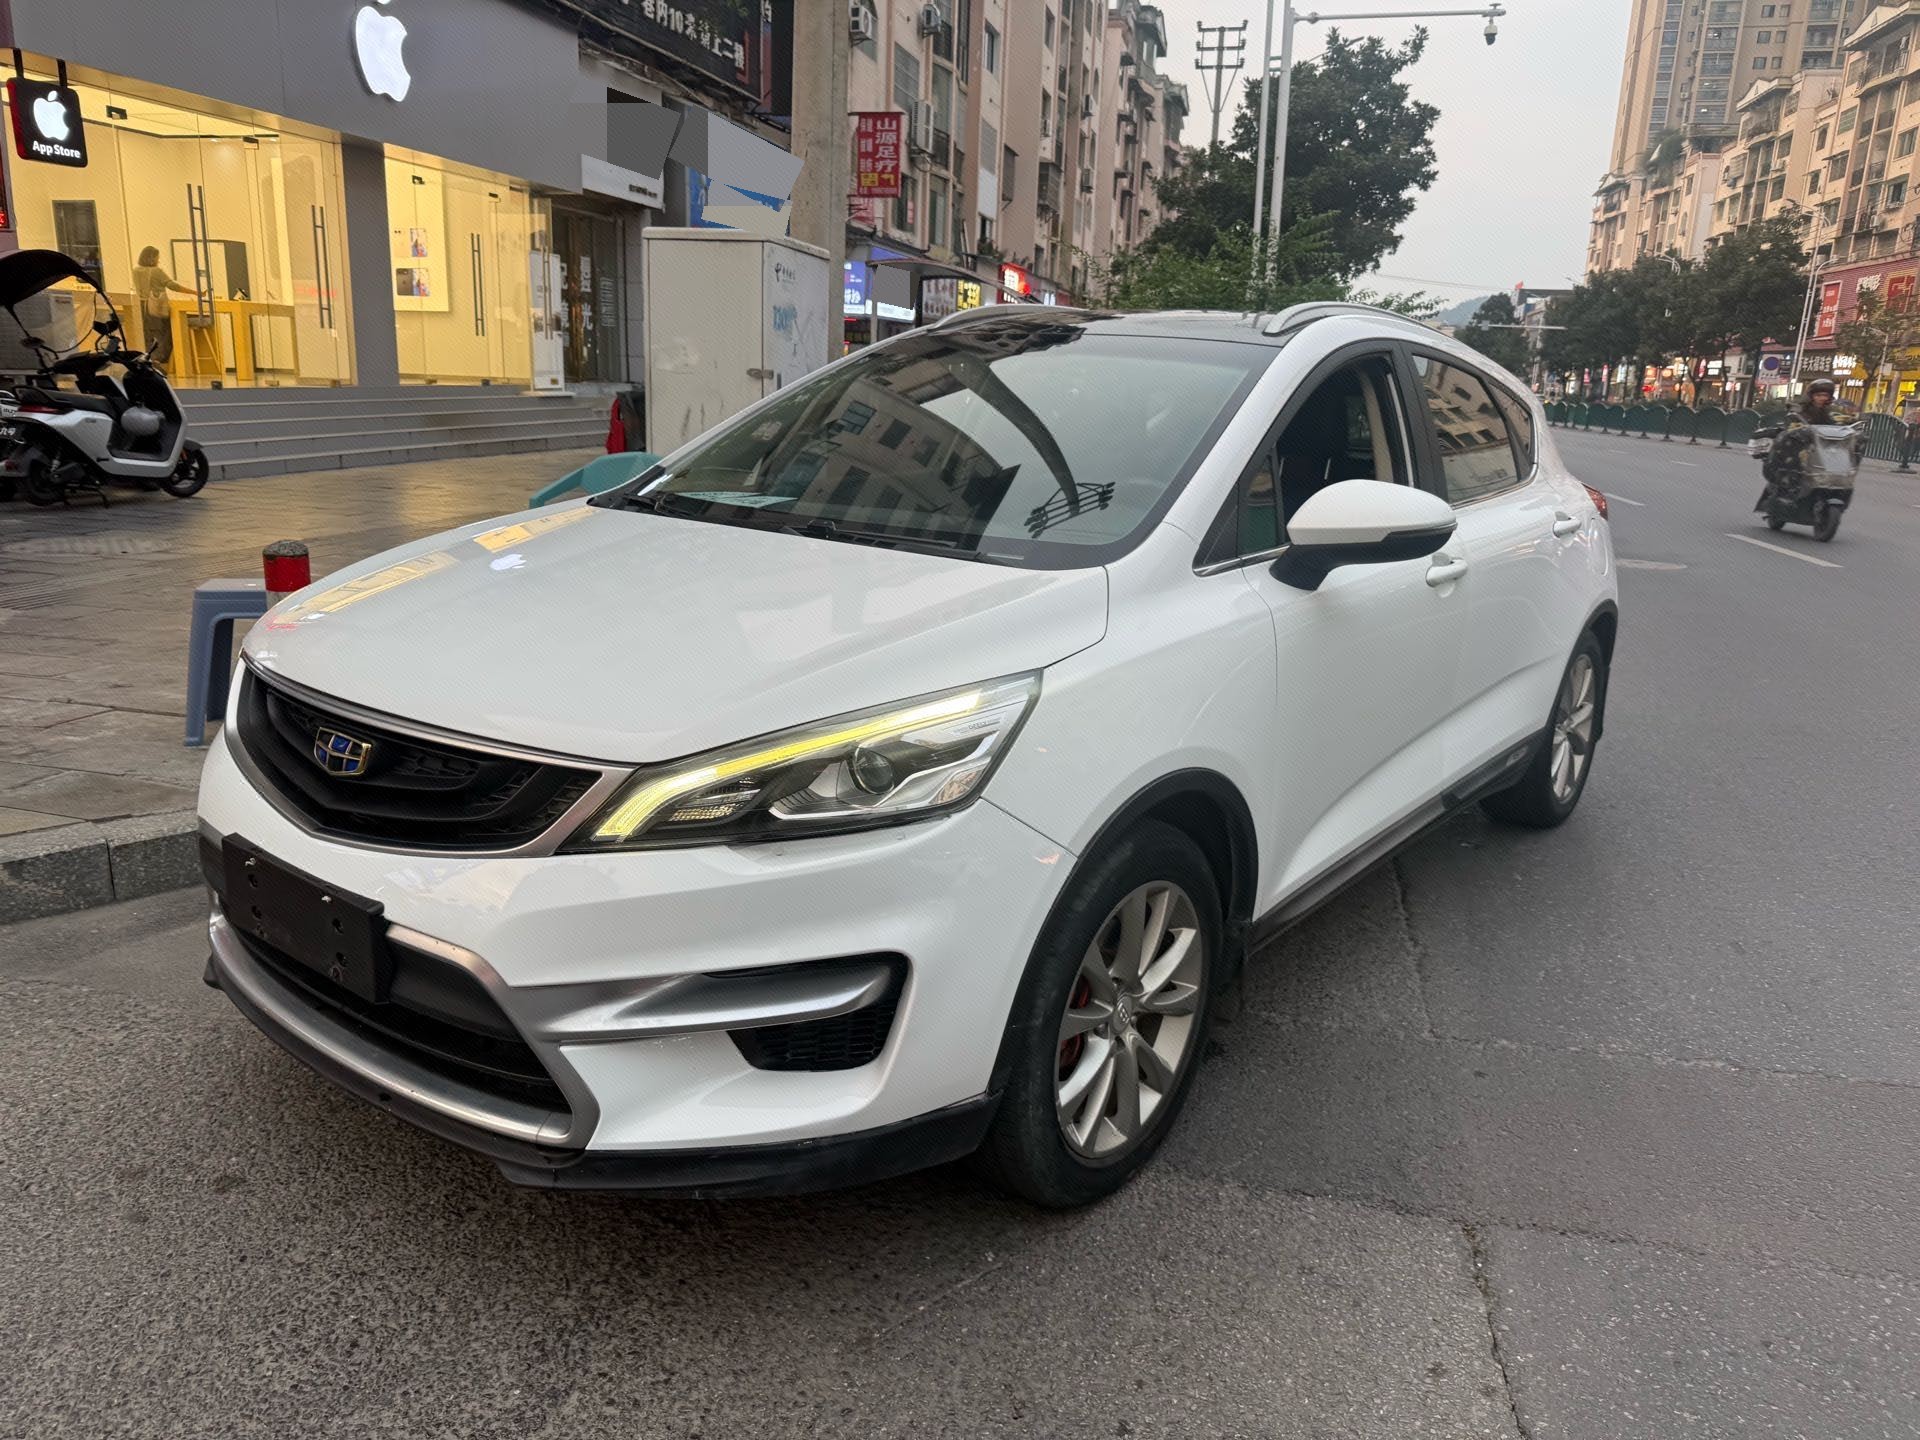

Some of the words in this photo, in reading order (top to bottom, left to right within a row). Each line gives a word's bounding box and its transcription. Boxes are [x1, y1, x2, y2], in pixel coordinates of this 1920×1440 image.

[32, 140, 53, 156] App
[54, 144, 82, 159] Store
[875, 117, 898, 173] 山源足疗
